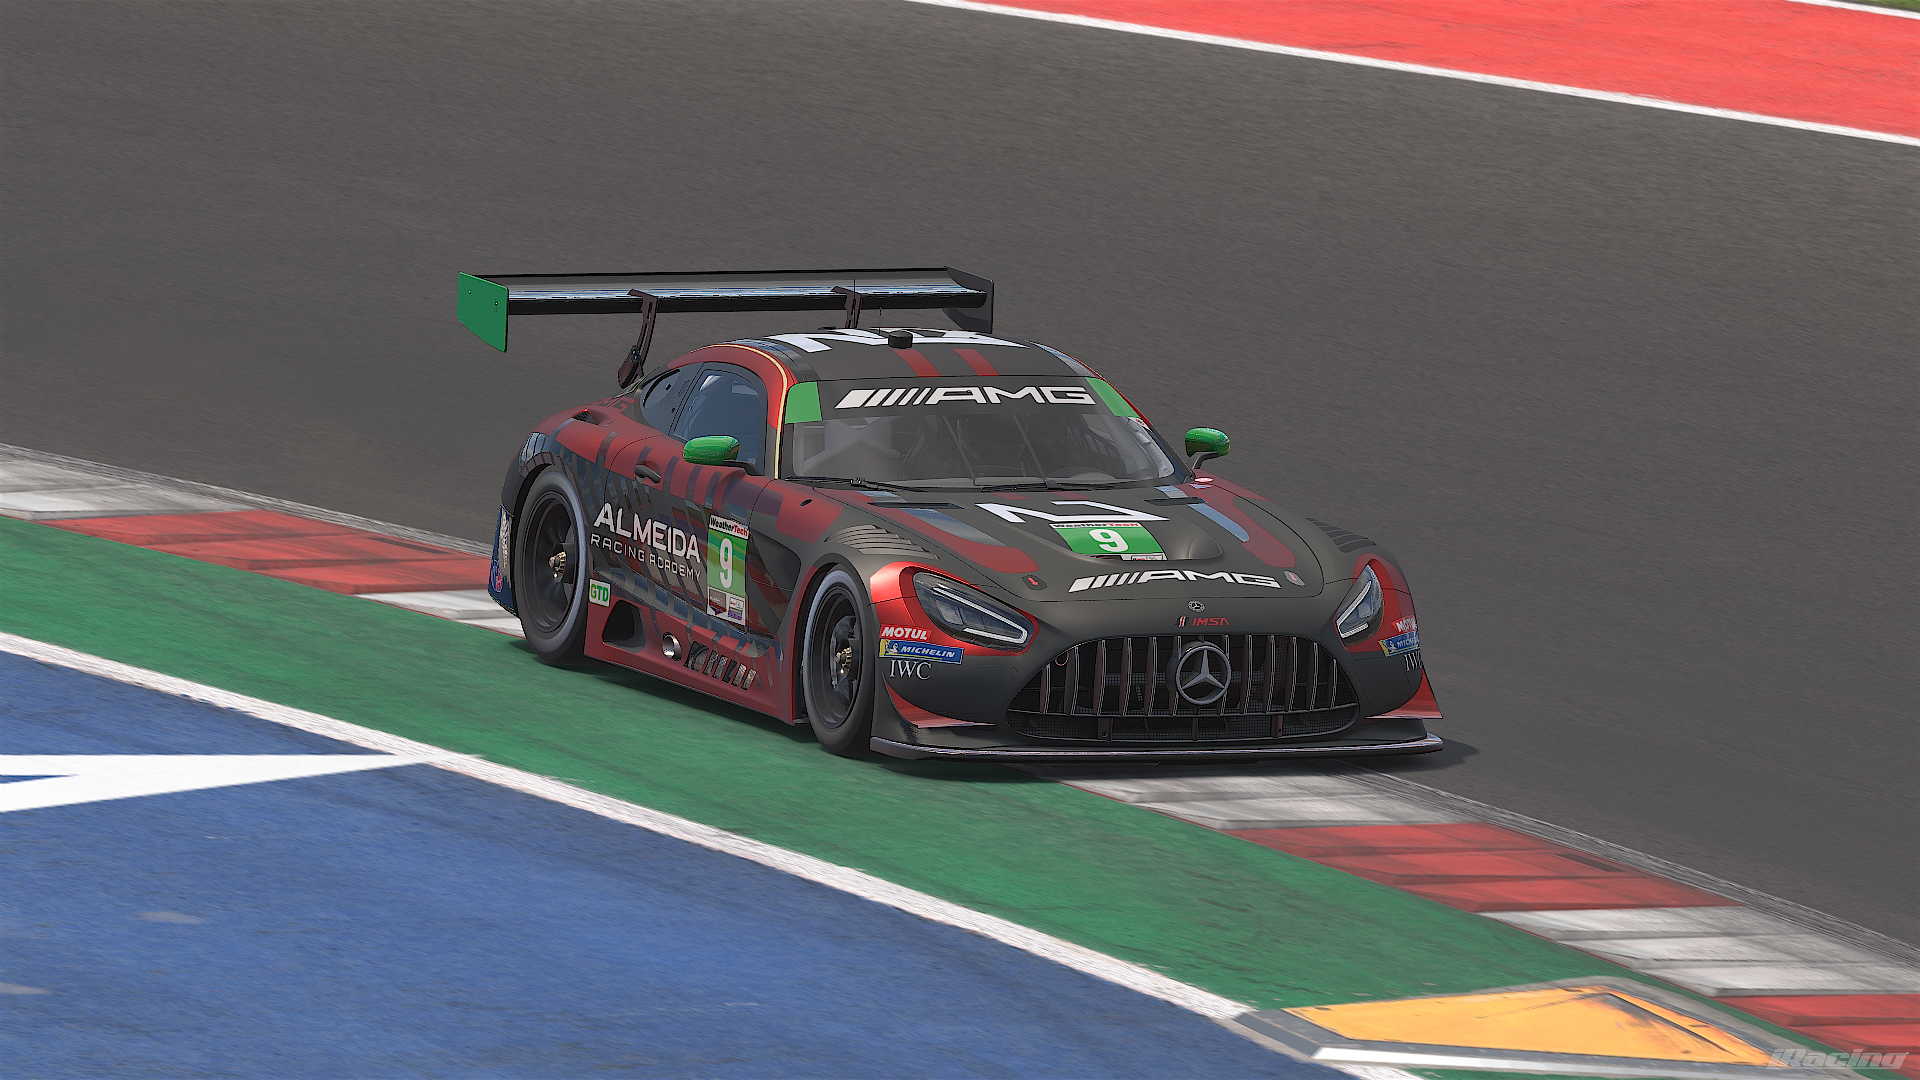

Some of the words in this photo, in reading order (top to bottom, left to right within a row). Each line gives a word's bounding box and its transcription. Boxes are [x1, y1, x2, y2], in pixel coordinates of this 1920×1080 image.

[924, 386, 1097, 406] AMG
[593, 502, 701, 564] ALMEIDA
[709, 517, 748, 537] WeatherTech
[1089, 528, 1129, 553] 9
[590, 533, 645, 562] RACING
[649, 553, 702, 581] ACADEMY
[720, 538, 732, 588] 9
[1136, 569, 1282, 589] AMG
[590, 582, 609, 603] GTD
[1191, 617, 1230, 627] IMSA
[881, 626, 929, 641] MOTUL
[899, 645, 956, 659] MICHELIN
[889, 659, 932, 680] IWC
